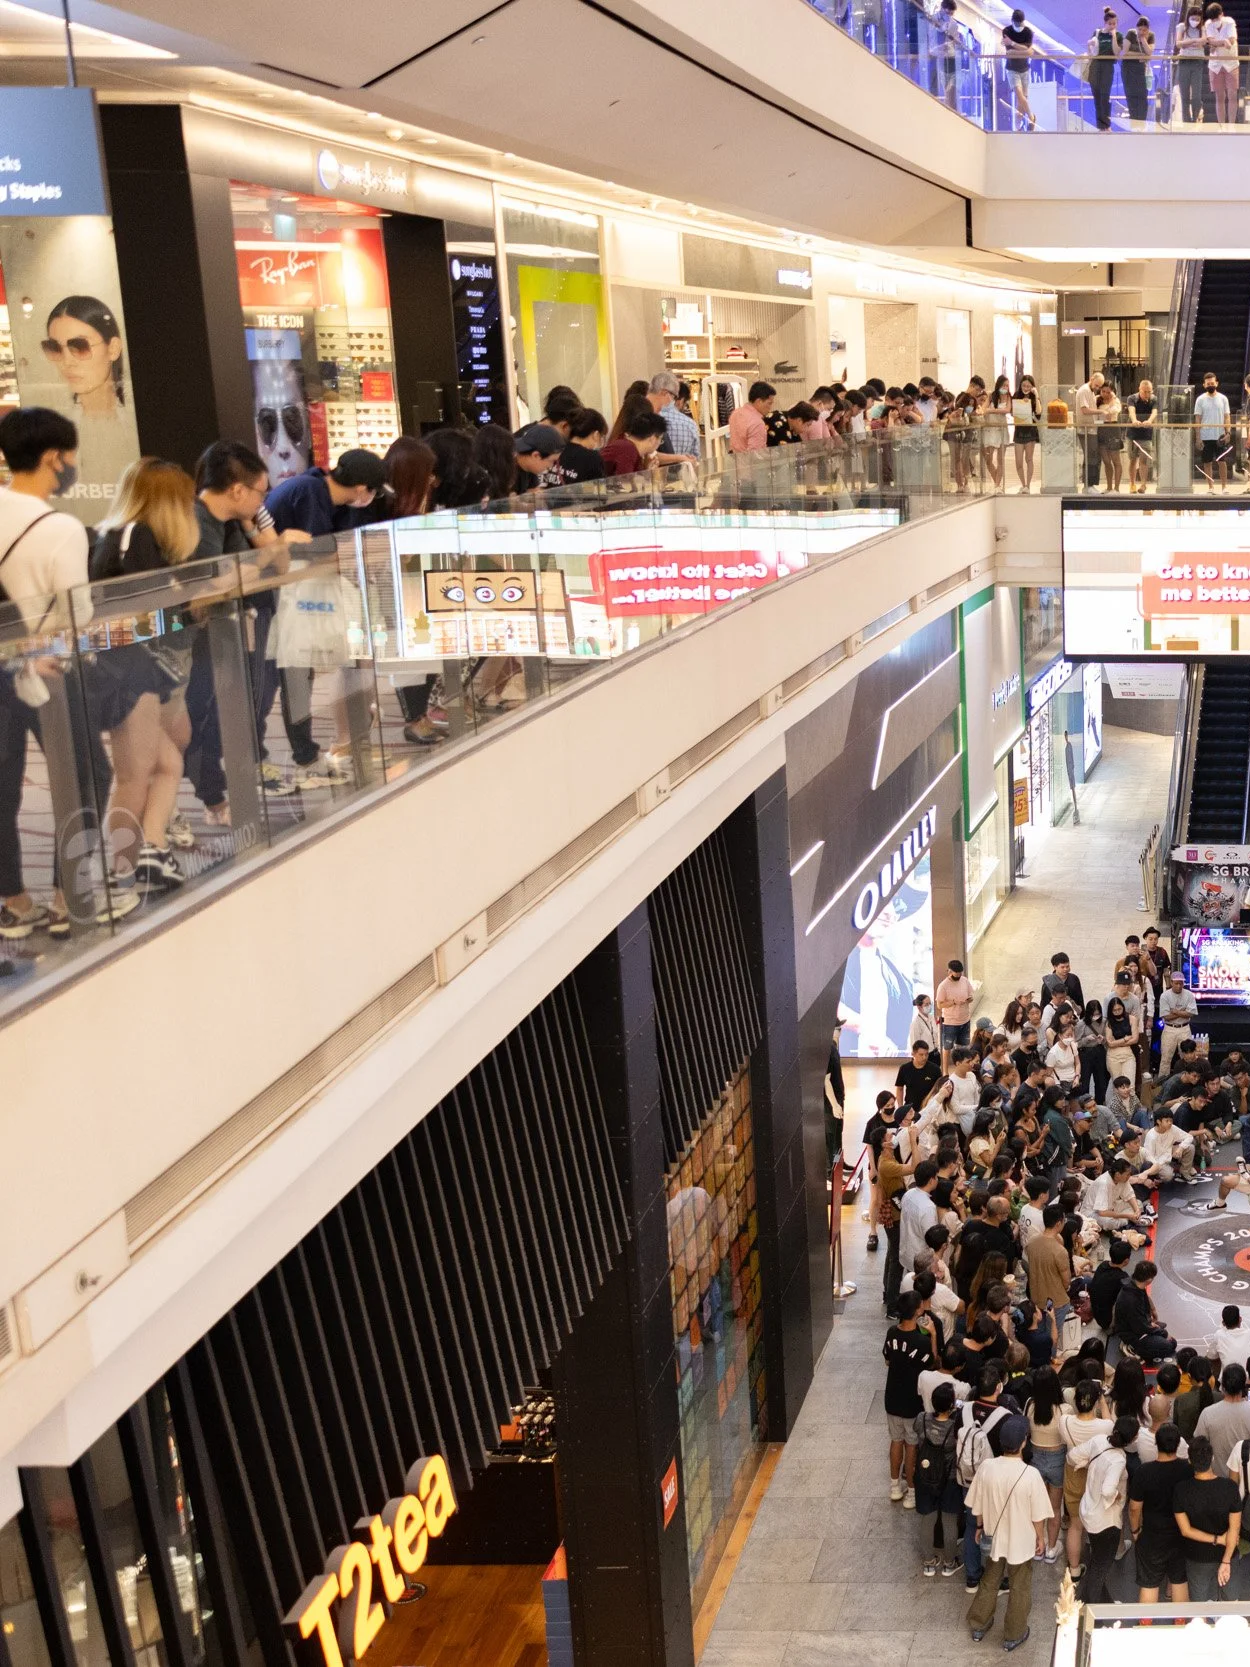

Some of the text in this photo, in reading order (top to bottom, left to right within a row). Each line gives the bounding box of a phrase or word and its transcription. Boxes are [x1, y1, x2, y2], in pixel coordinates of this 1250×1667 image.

[9, 182, 62, 203] Staples
[256, 314, 304, 328] THE ICON
[1157, 563, 1193, 580] Get
[1197, 563, 1219, 580] to
[1160, 587, 1193, 602] me
[1212, 867, 1229, 876] SG
[1193, 1238, 1228, 1284] CHAMPS
[664, 1475, 676, 1510] SALE
[298, 1454, 457, 1667] T2tea
